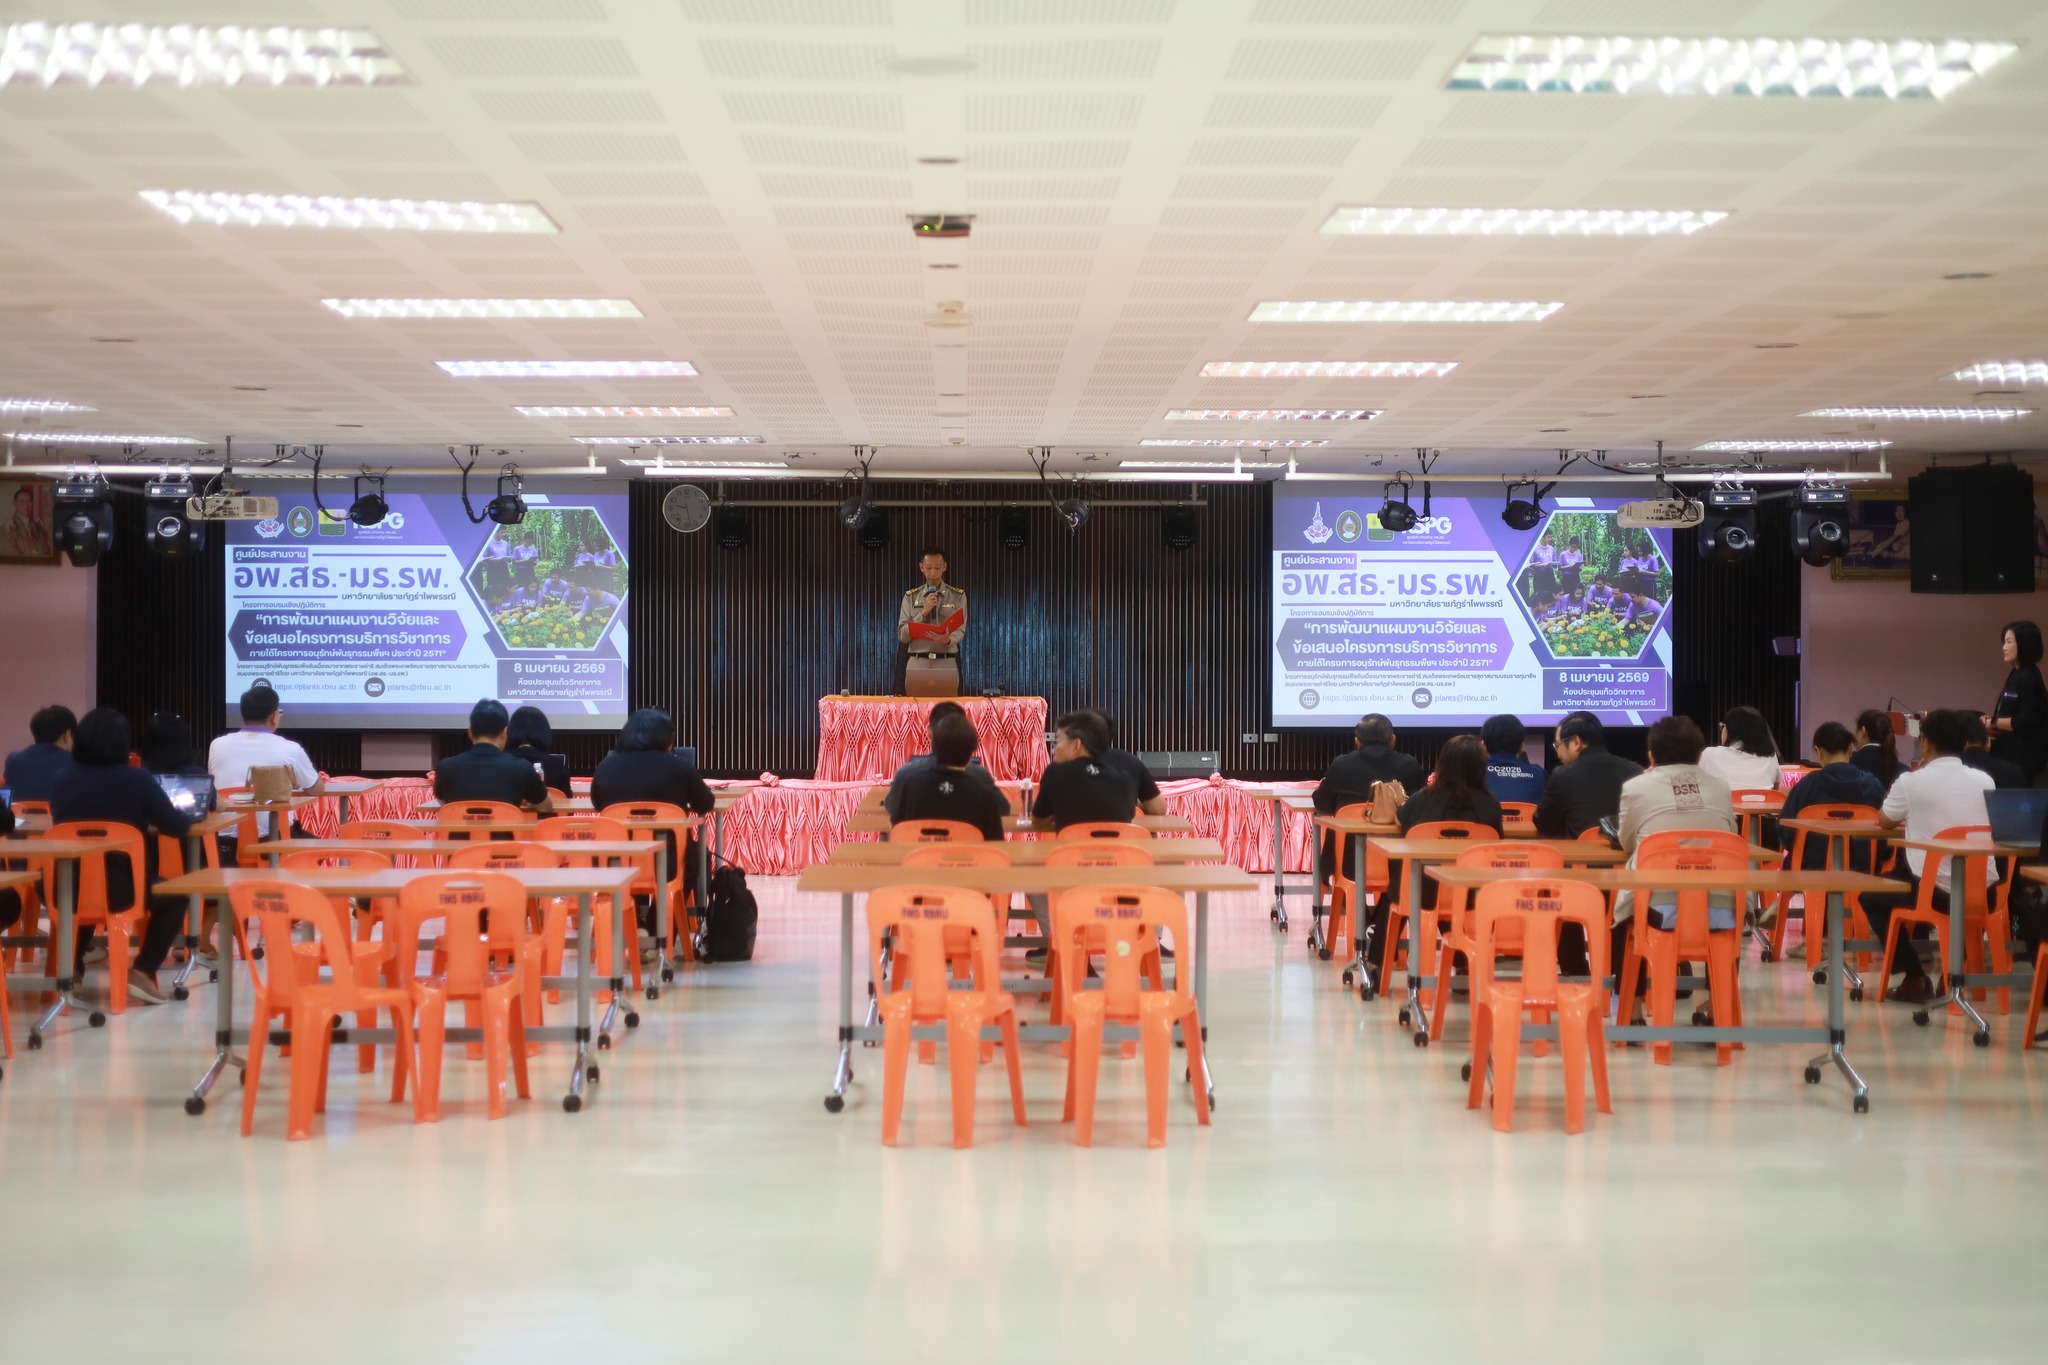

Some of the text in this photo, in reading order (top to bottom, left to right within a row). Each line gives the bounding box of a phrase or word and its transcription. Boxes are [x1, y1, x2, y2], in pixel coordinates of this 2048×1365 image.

[1402, 516, 1453, 534] SPG
[235, 548, 307, 561] ศูนย์ประสานงาน
[1283, 555, 1355, 567] ศูนย์ประสานงาน
[234, 565, 449, 588] อพ.สธ.-มร.รพ.
[1282, 572, 1496, 595] อพ.สธ.-มร.รพ.
[244, 630, 451, 645] ข้อเสนอโครงการบริการวิชาการ
[1292, 639, 1498, 654] ข้อเสนอโครงการบริการวิชาการ
[391, 649, 422, 658] ประจำปี
[513, 663, 606, 673] 8 เมษายน 2569
[1438, 658, 1468, 667] ประจำปี
[1559, 672, 1650, 683] 8 เมษายน 2569
[387, 683, 451, 692] plants@rbru.ac.th
[1434, 694, 1498, 703] plants@rbru.ac.th
[1672, 783, 1700, 796] BSRI
